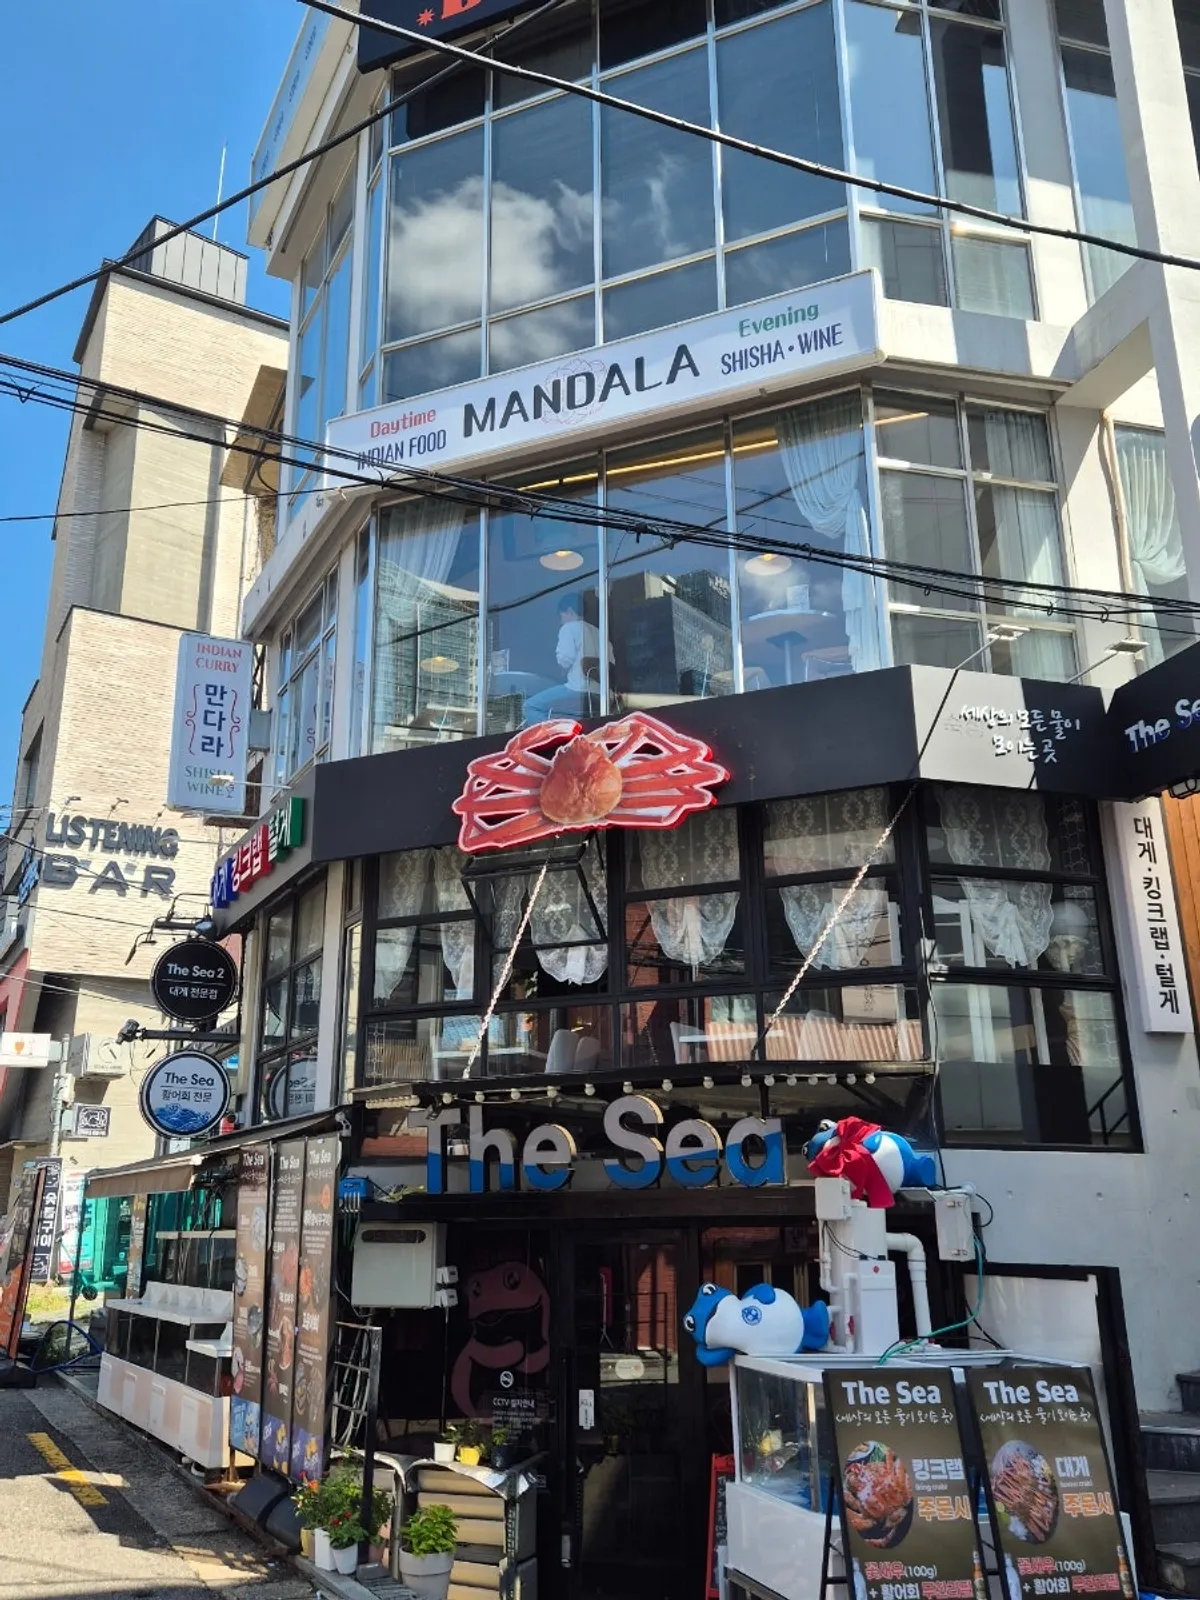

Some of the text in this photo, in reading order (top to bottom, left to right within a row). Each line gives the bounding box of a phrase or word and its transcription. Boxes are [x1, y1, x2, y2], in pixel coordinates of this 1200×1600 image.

[739, 304, 819, 338] Evening
[721, 323, 844, 375] SHISHA WINE
[463, 343, 700, 438] MANDALA
[370, 409, 436, 439] Daytime
[357, 429, 447, 471] INDIAN FOOD
[196, 643, 242, 659] INDIAN
[195, 658, 240, 674] CURRY
[201, 683, 228, 758] 만다라
[959, 704, 1080, 740] 세상의 모든 물이
[992, 734, 1058, 763] 모이는 곳
[1124, 718, 1171, 753] The
[187, 781, 224, 796] WINE
[46, 812, 179, 858] LISTENING
[43, 853, 177, 899] BAR
[167, 963, 225, 979] The Sea 2
[165, 1072, 215, 1086] The Sea
[408, 1094, 788, 1195] The Sea
[841, 1379, 942, 1406] The Sea
[983, 1379, 1080, 1405] The Sea
[911, 1458, 966, 1481] 킹크랩
[1055, 1456, 1090, 1478] 대게
[917, 1495, 972, 1522] 주문시
[1062, 1491, 1114, 1518] 주문시
